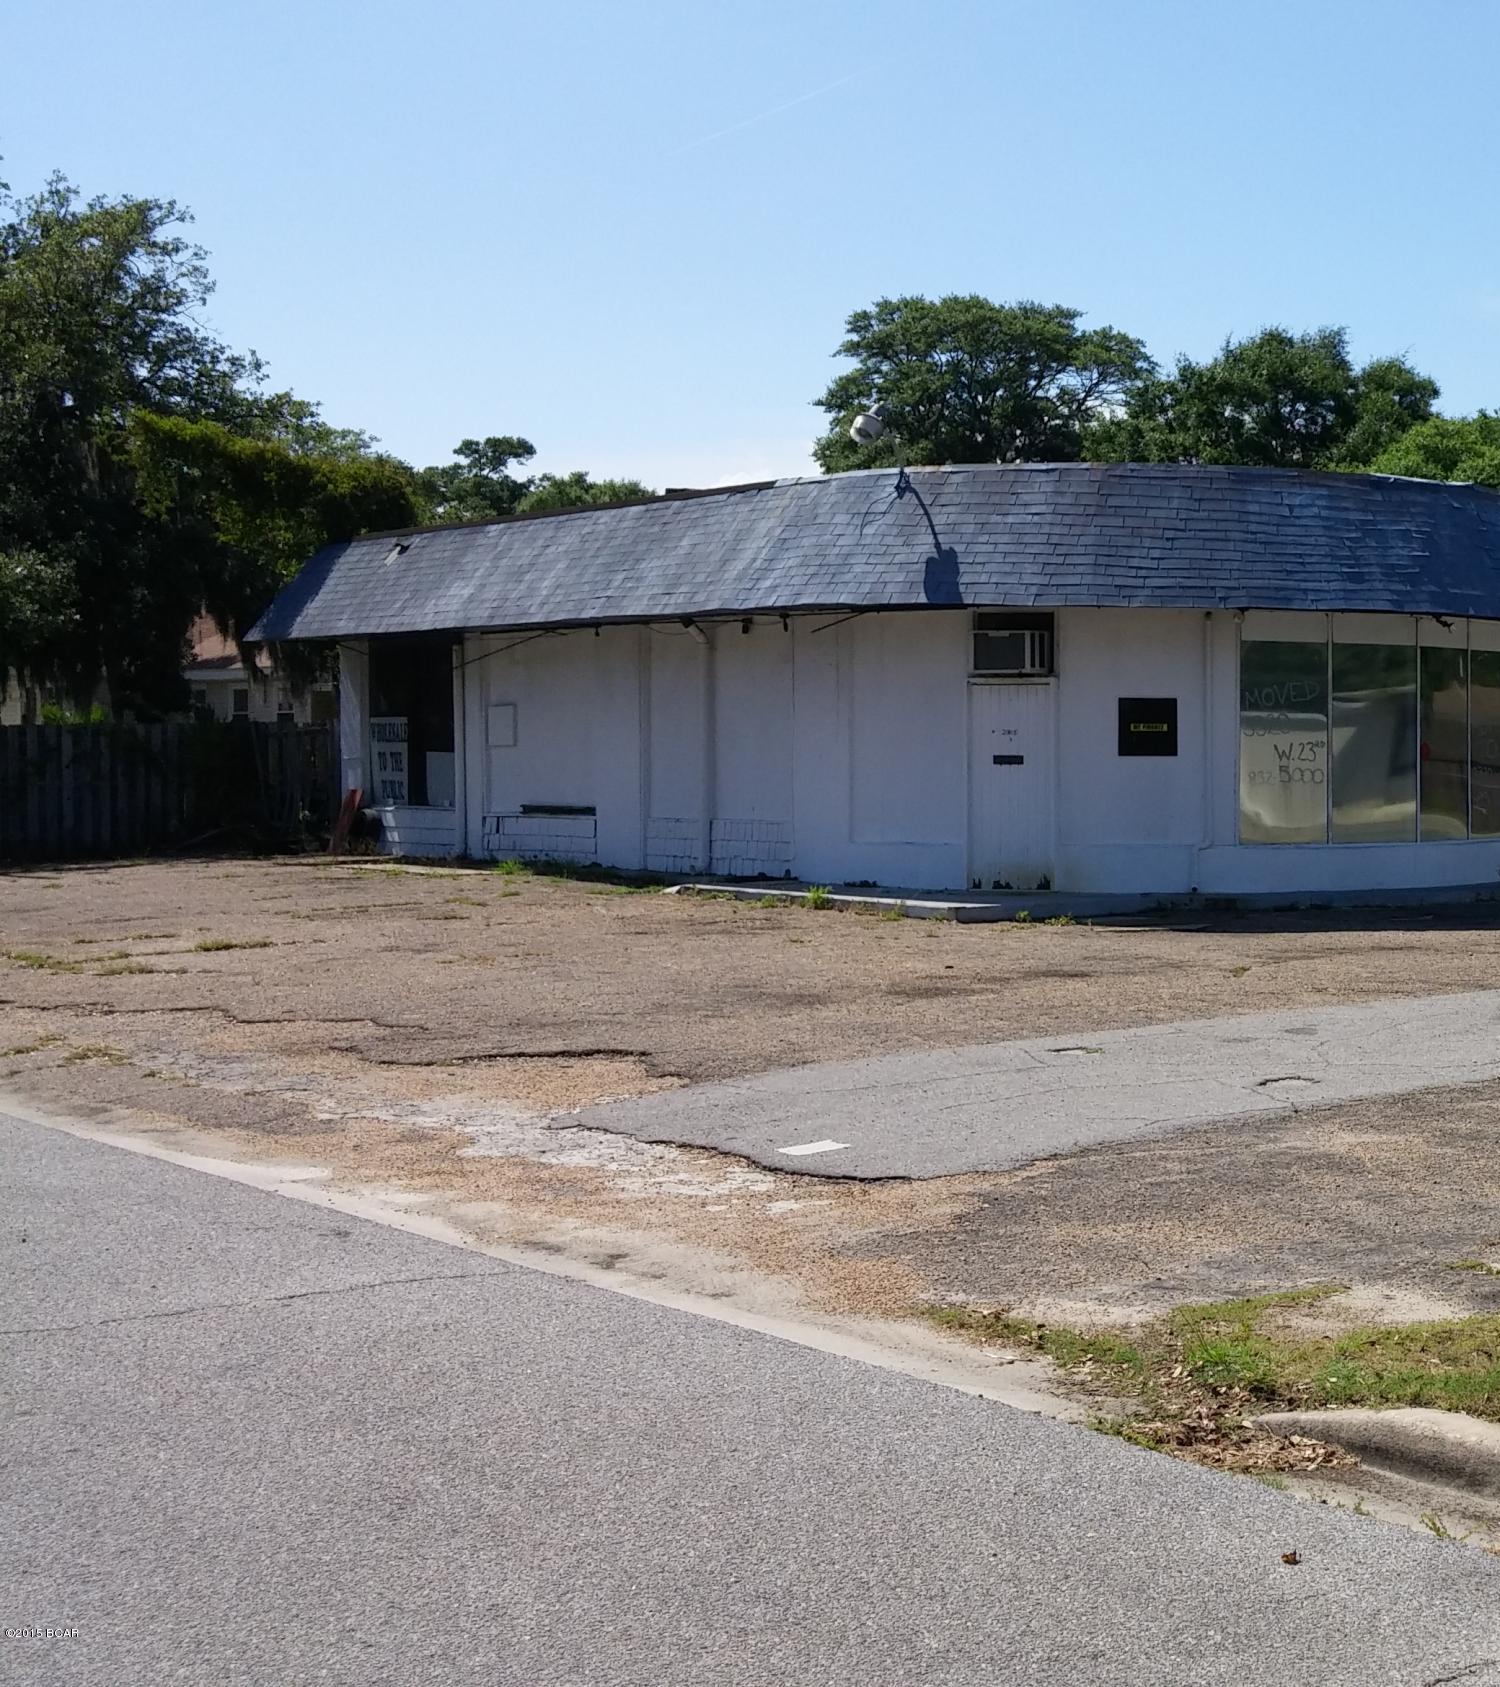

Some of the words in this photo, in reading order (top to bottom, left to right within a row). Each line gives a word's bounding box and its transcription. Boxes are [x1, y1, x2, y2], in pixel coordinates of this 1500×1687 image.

[1245, 680, 1321, 710] MOVED
[378, 752, 387, 771] TO
[390, 752, 403, 772] THE
[381, 780, 405, 800] PUBLIC
